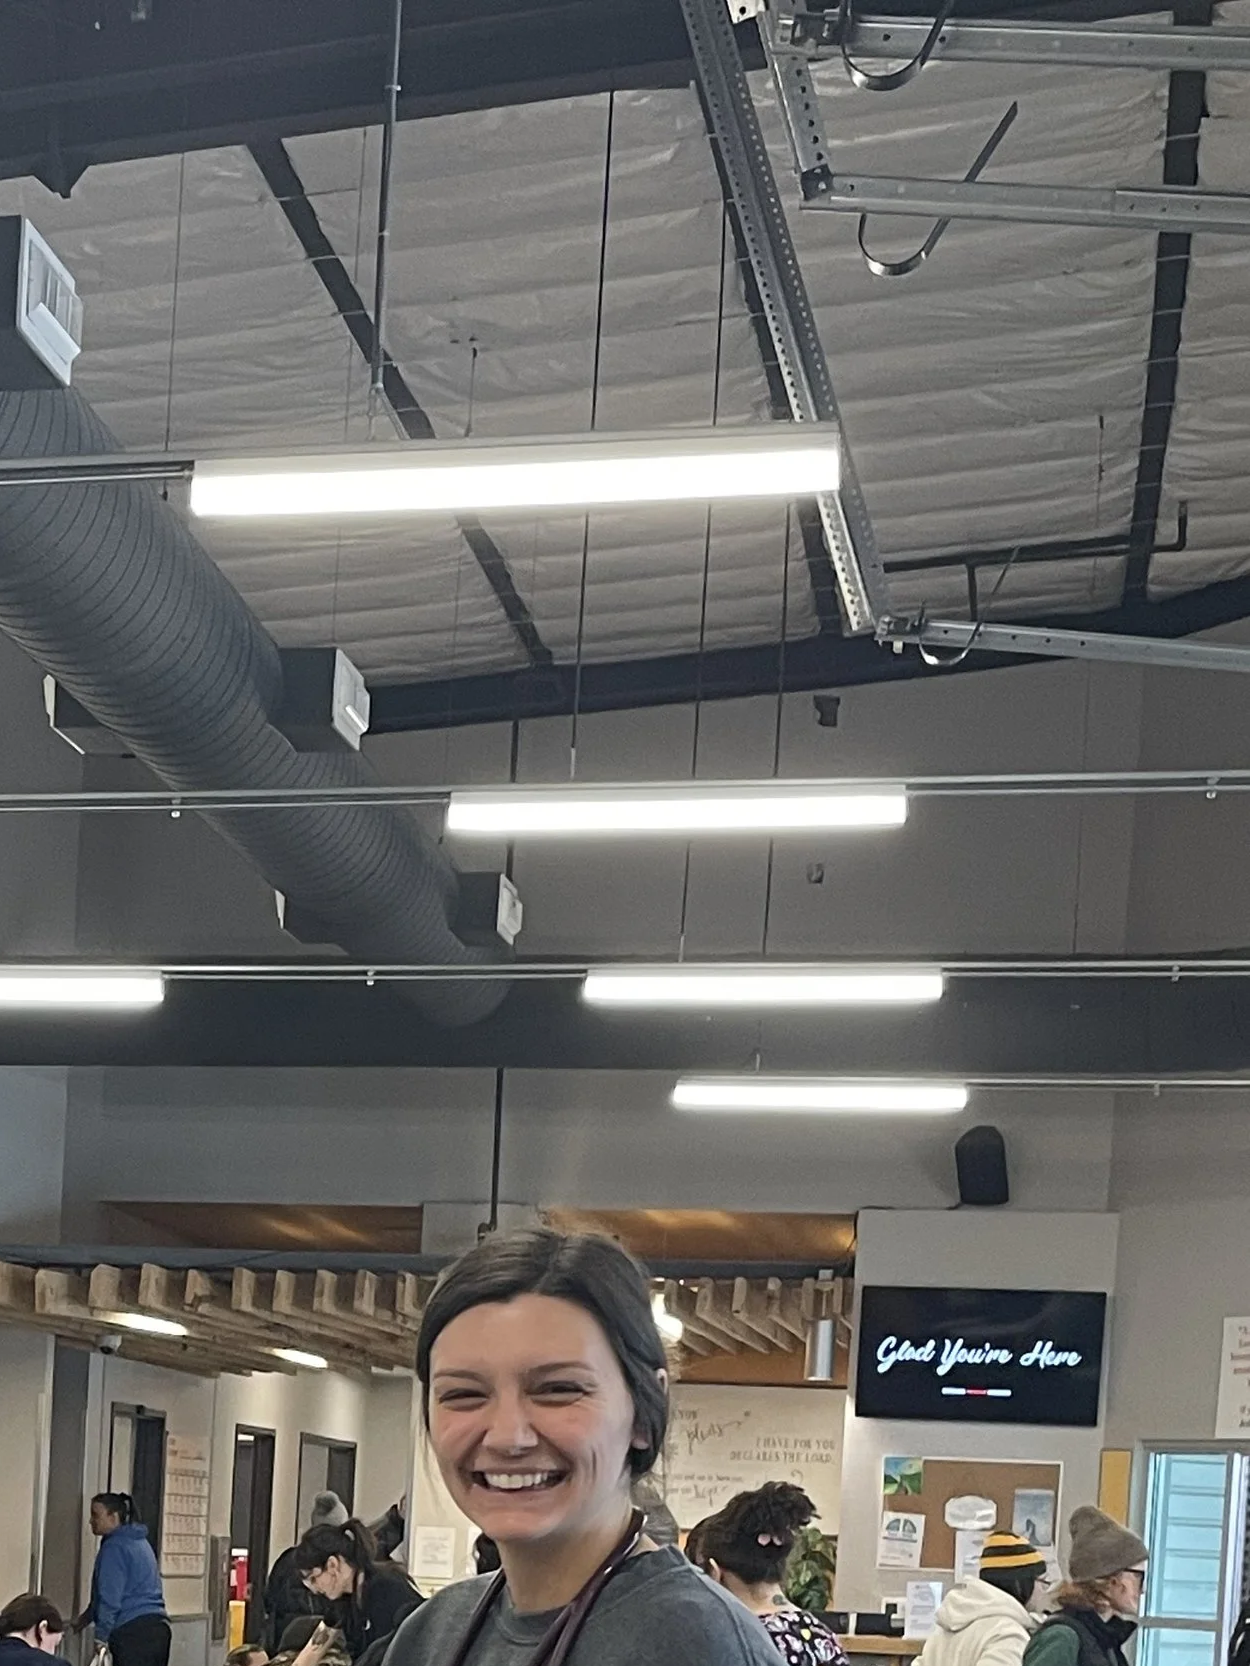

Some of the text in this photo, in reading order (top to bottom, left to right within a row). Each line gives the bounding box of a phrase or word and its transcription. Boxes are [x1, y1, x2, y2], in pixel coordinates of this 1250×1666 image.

[876, 1336, 1082, 1376] Glad You're Here
